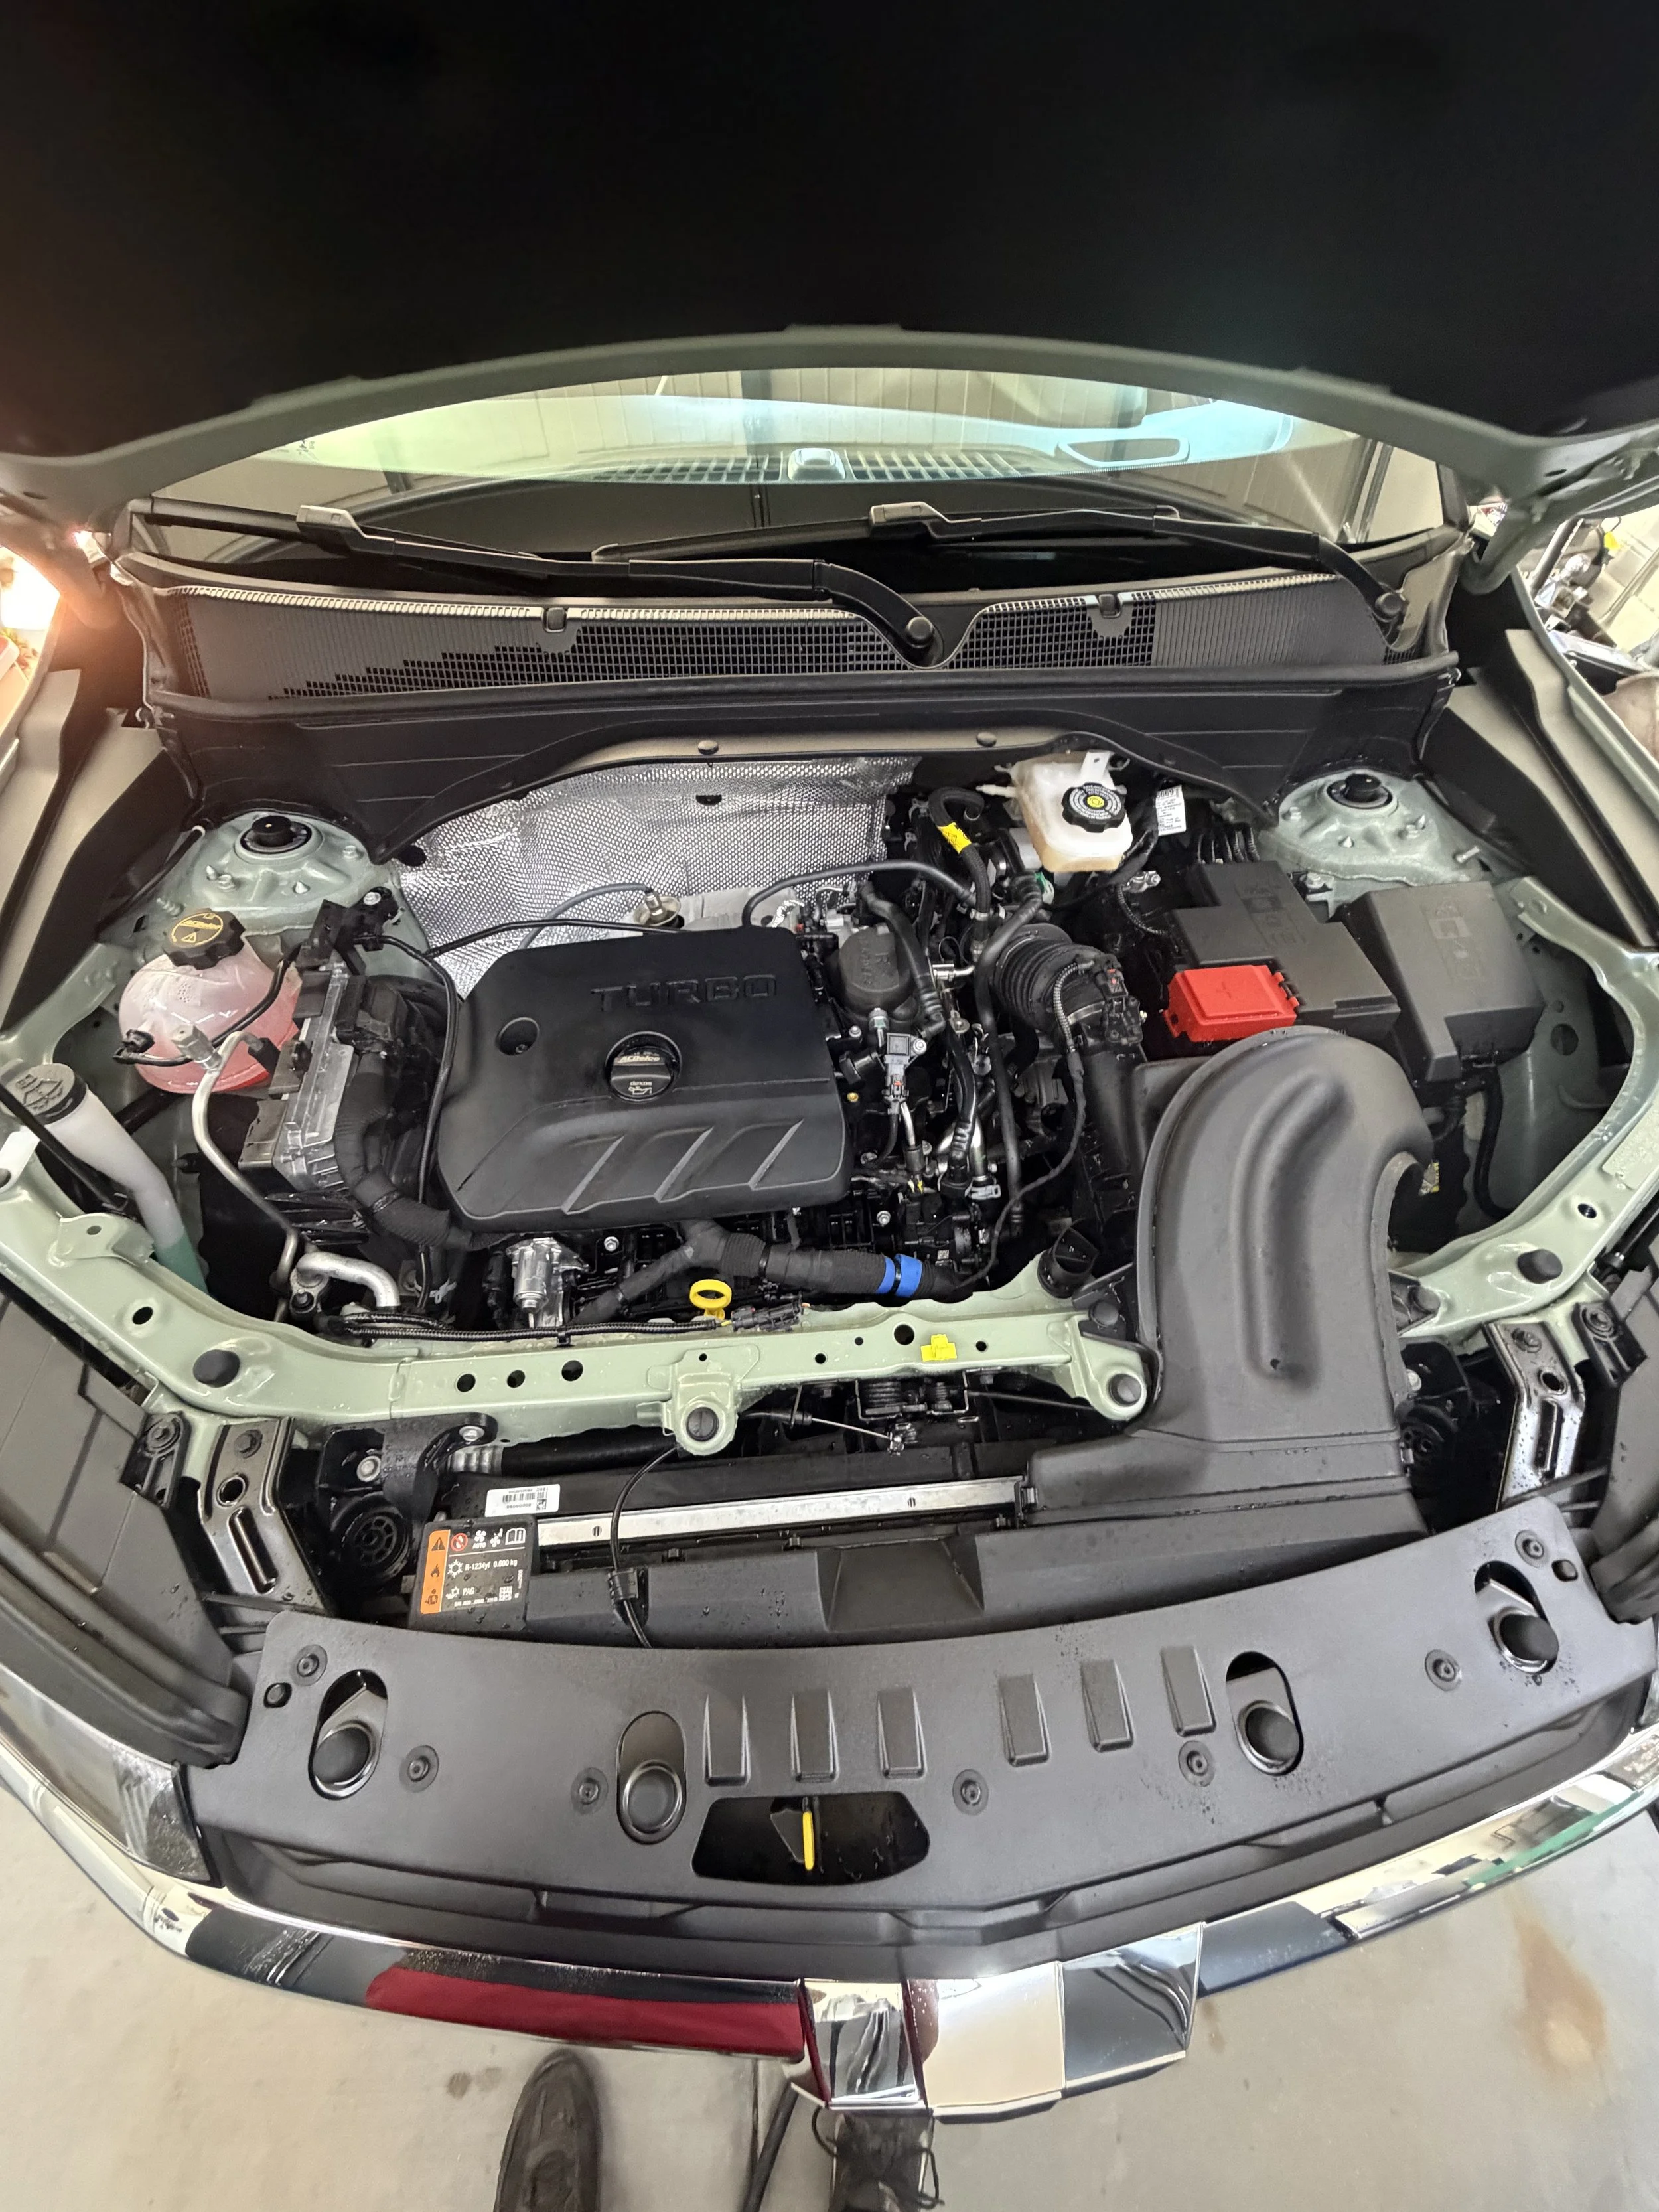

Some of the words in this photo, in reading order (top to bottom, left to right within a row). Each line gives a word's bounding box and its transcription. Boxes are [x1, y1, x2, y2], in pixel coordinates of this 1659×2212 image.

[590, 974, 776, 1012] TURBO
[616, 1055, 661, 1063] ACDelco
[465, 1561, 491, 1571] R-1234yf
[510, 1558, 518, 1567] kg
[463, 1587, 475, 1596] PAG
